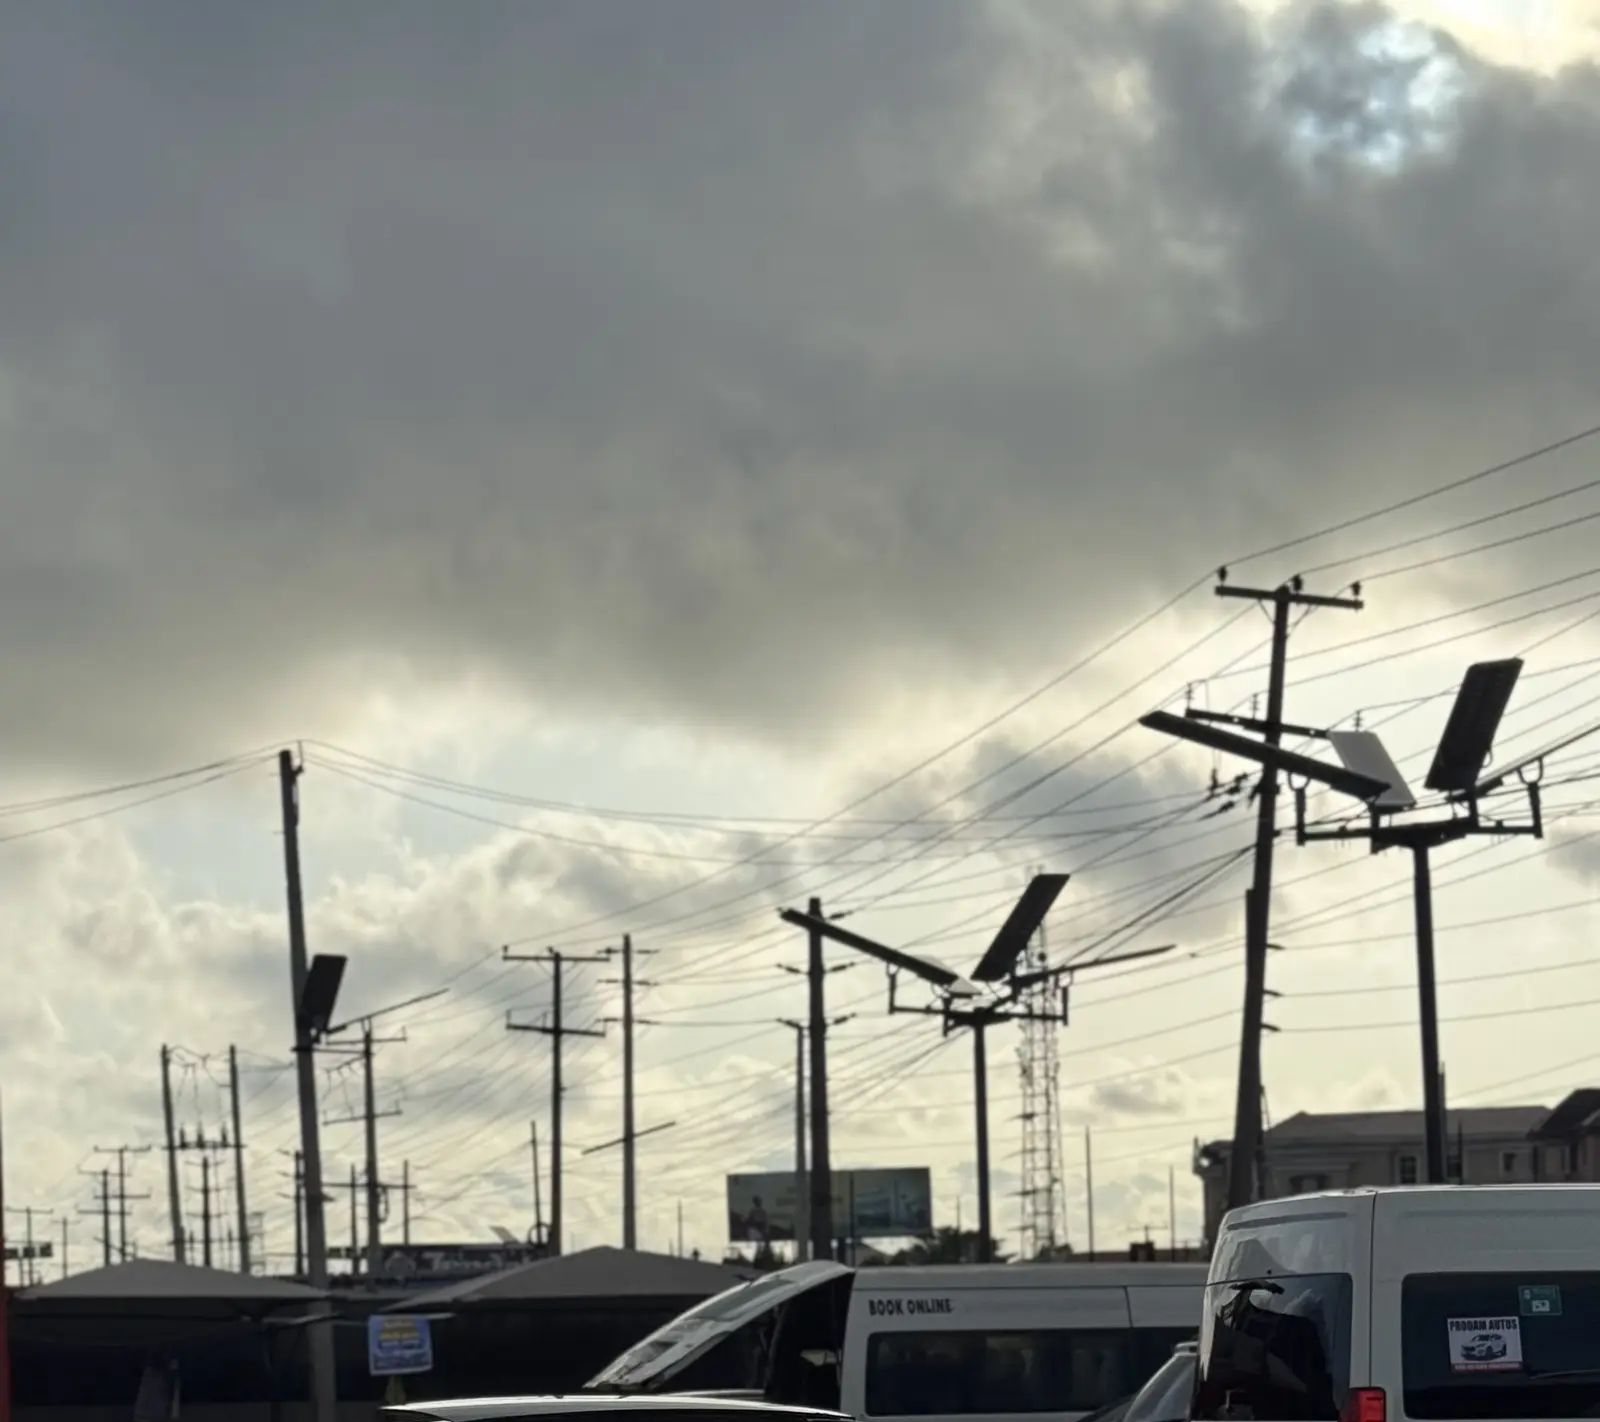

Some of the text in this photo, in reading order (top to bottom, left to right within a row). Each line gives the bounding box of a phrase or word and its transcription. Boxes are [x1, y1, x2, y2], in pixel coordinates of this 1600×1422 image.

[868, 1298, 955, 1316] BOOK ONLINE
[1489, 1319, 1518, 1331] AUTOS
